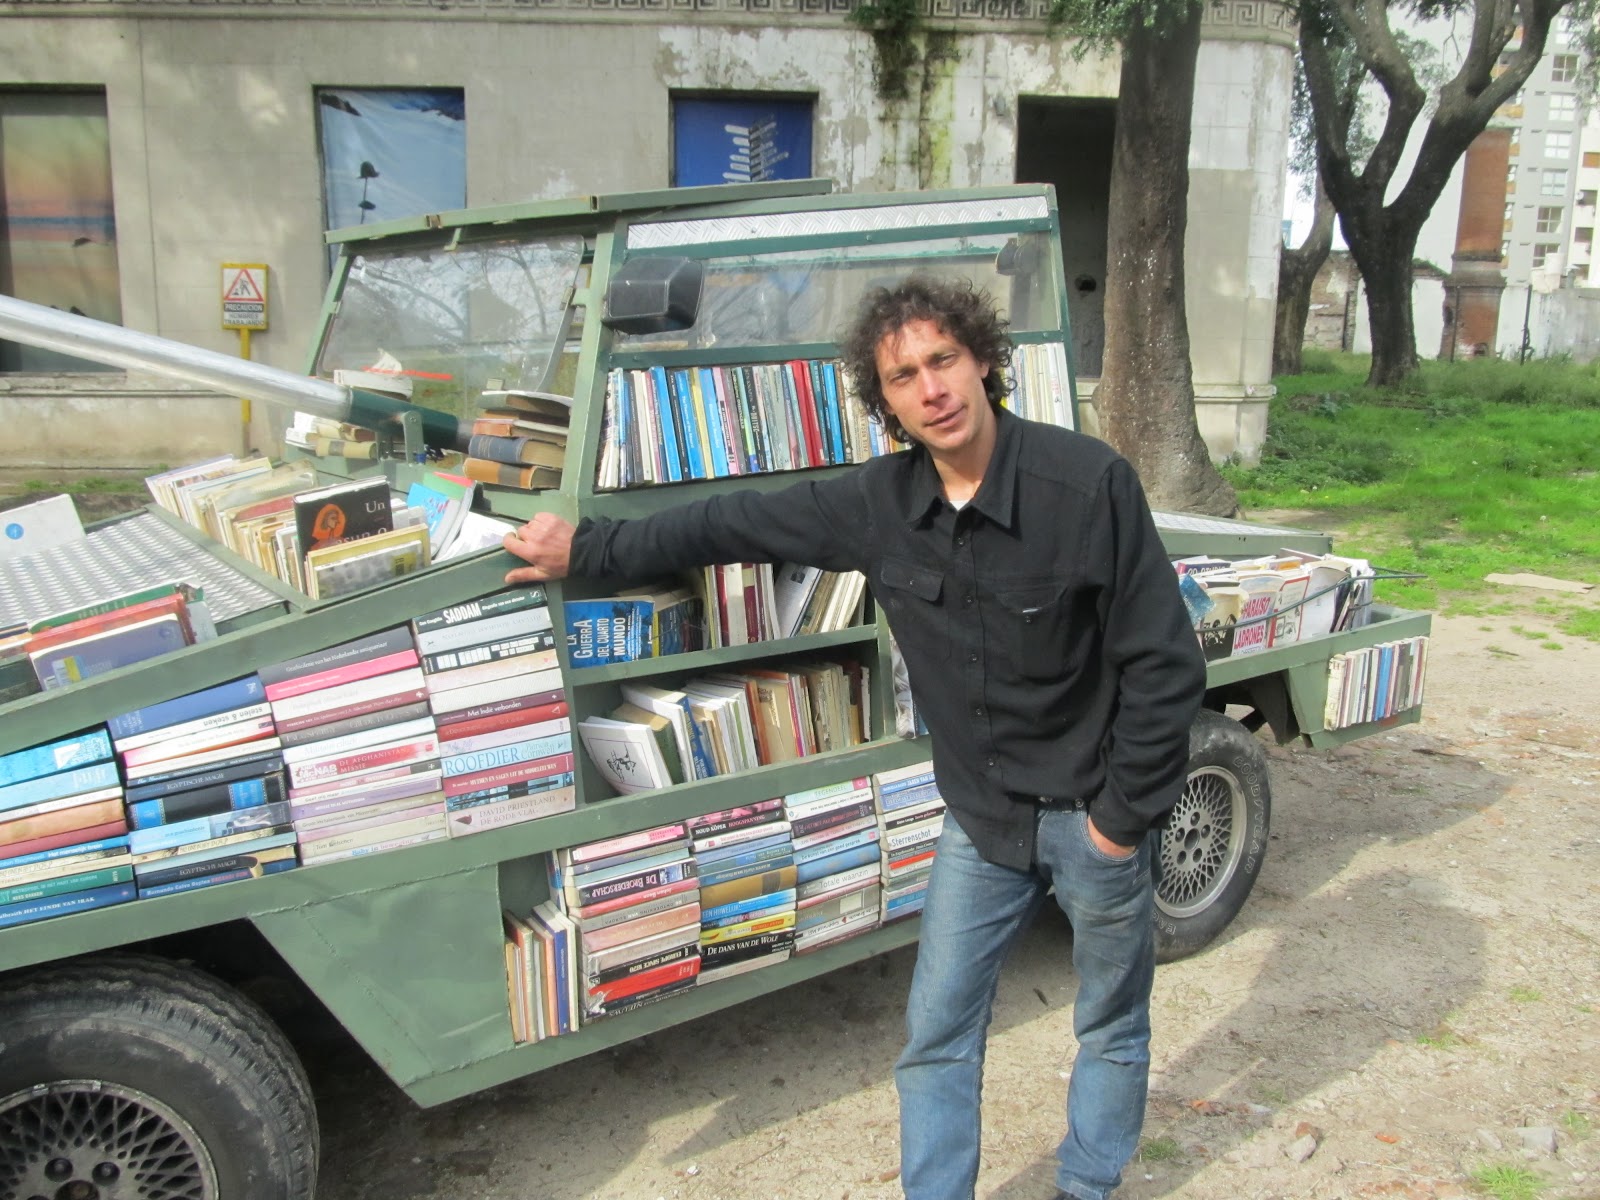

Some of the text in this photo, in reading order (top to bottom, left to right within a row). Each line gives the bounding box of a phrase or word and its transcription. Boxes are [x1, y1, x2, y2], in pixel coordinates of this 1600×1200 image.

[366, 501, 386, 513] Un
[442, 602, 481, 623] SADDAM
[567, 634, 577, 646] LA
[573, 619, 593, 659] GUERRA
[597, 618, 609, 657] DEL CUARTO
[613, 617, 626, 656] MUNDO
[1233, 624, 1265, 650] LADRONES
[239, 706, 263, 718] stelen
[467, 709, 479, 717] Met
[493, 701, 521, 711] verbonden
[202, 715, 229, 728] steken
[340, 762, 366, 772] MISSIE
[444, 745, 555, 775] ROOFDIER Cornwell
[298, 763, 337, 778] McNAB
[166, 775, 204, 790] EGYPTISCHE
[813, 784, 847, 798] TEGENDEEL
[478, 795, 556, 817] DAVID PRIESTLAND
[480, 817, 491, 825] DE
[493, 812, 516, 822] RODE
[1233, 757, 1264, 873] GOODYEAR
[695, 827, 710, 835] NOUD
[709, 822, 726, 831] KÖPER
[890, 828, 932, 847] Sterrenschot
[351, 846, 369, 856] Baby
[806, 850, 819, 858] kunst
[844, 838, 860, 847] gesprek
[178, 862, 217, 875] EGYPTISCHE
[818, 868, 869, 889] Totale waanzin
[590, 877, 644, 897] BROEDERSCHAP
[23, 906, 38, 914] HET
[38, 902, 61, 911] EINDE
[61, 899, 76, 907] VAN
[76, 896, 95, 904] IRAK
[702, 904, 739, 919] EEN HUWELIJK
[603, 915, 627, 924] EUROPA
[706, 933, 778, 955] DE DANS VAN DE WOLF
[642, 957, 660, 968] SINCE
[659, 950, 682, 963] EUROPE
[607, 1001, 644, 1017] NIEUWS
